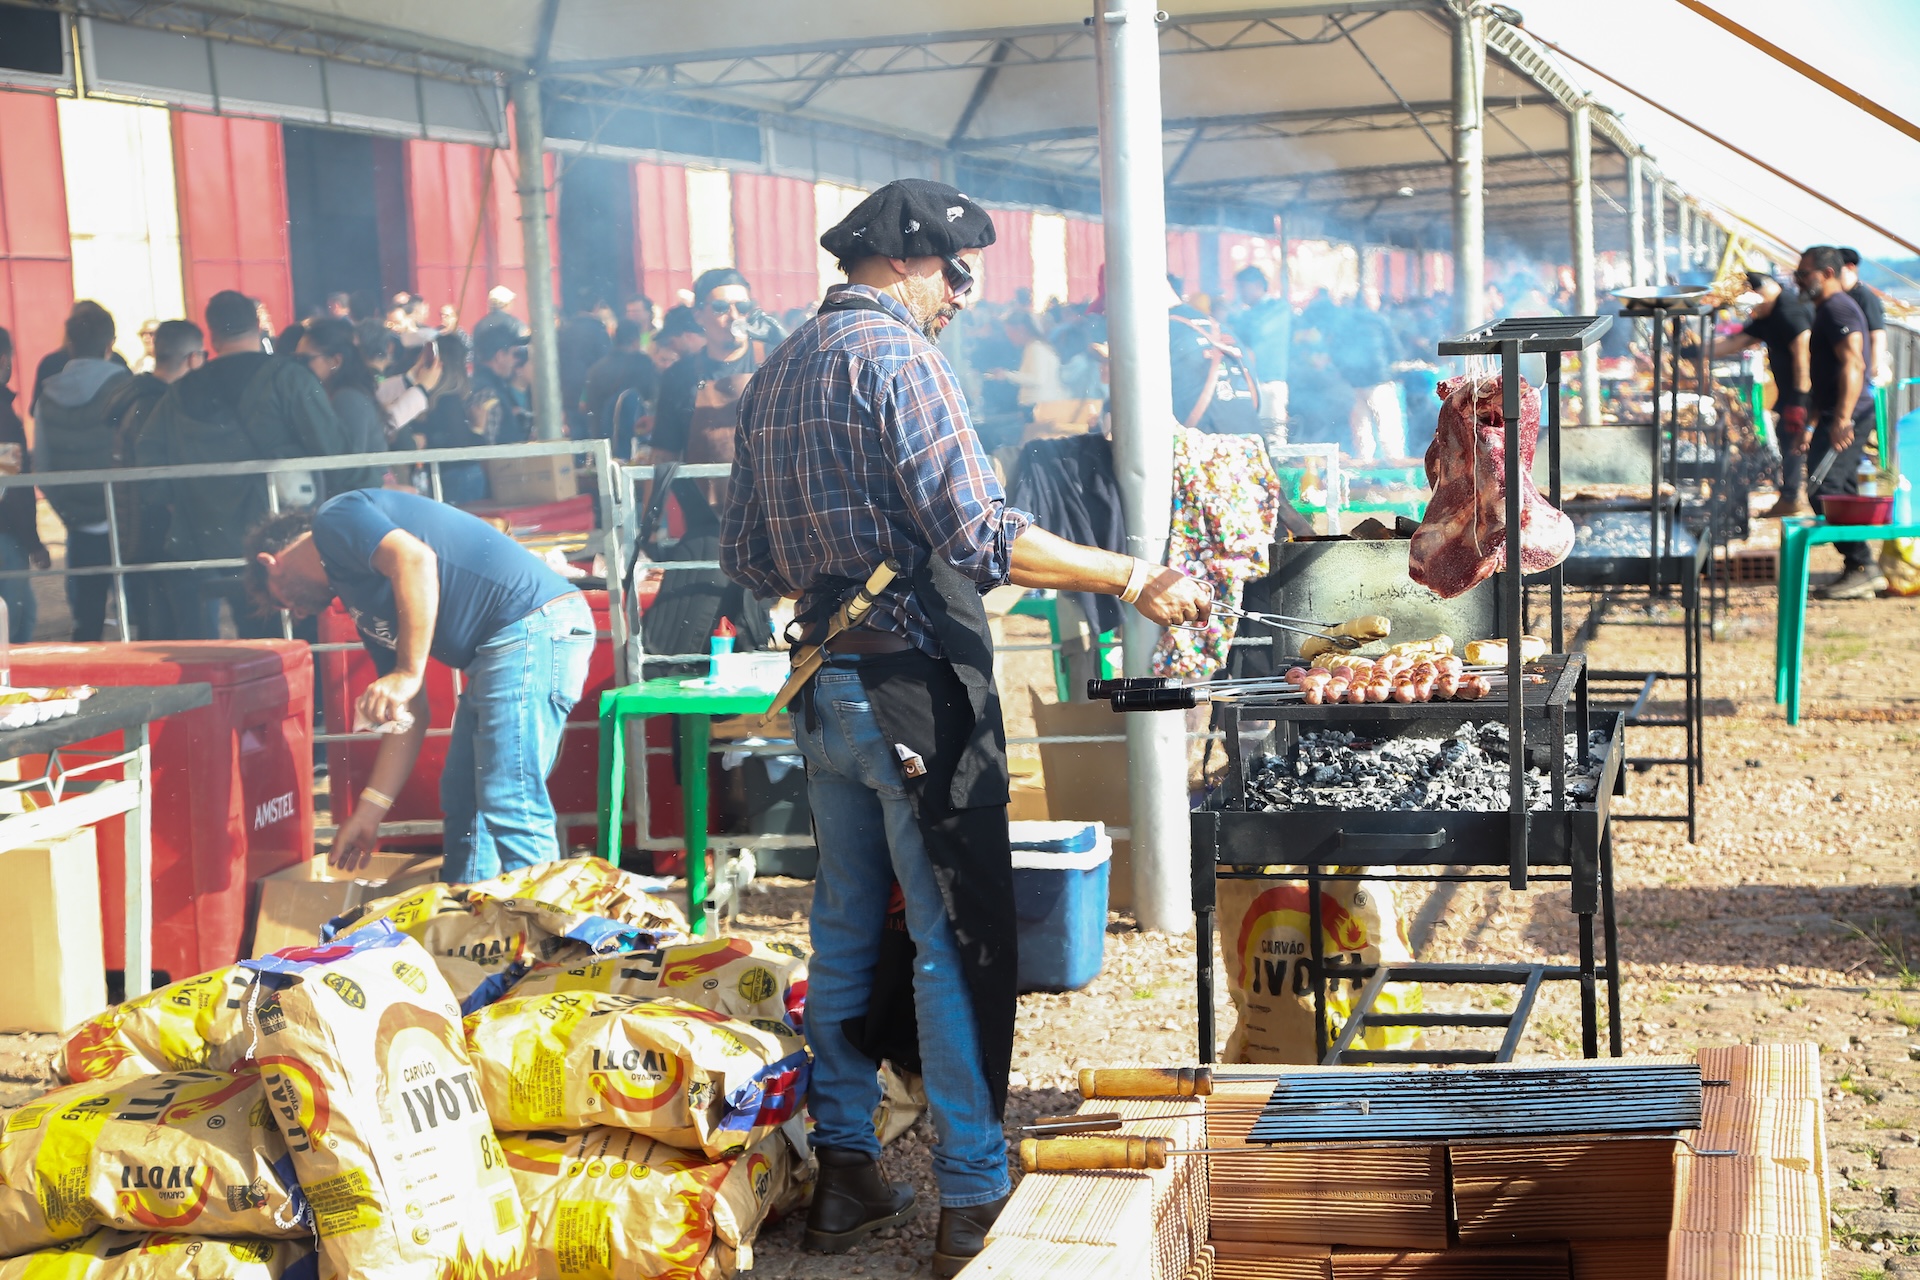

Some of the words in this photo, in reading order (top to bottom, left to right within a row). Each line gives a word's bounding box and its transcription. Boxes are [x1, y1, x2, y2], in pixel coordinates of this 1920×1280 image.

[254, 791, 295, 831] AMSTEL
[1261, 940, 1305, 955] CARVÃO
[403, 1060, 436, 1083] CARVÃO
[592, 1049, 667, 1072] IVOTI
[284, 1078, 299, 1111] CARVÃO
[121, 1166, 195, 1189] IVOTI
[158, 1190, 186, 1200] CARVÃO
